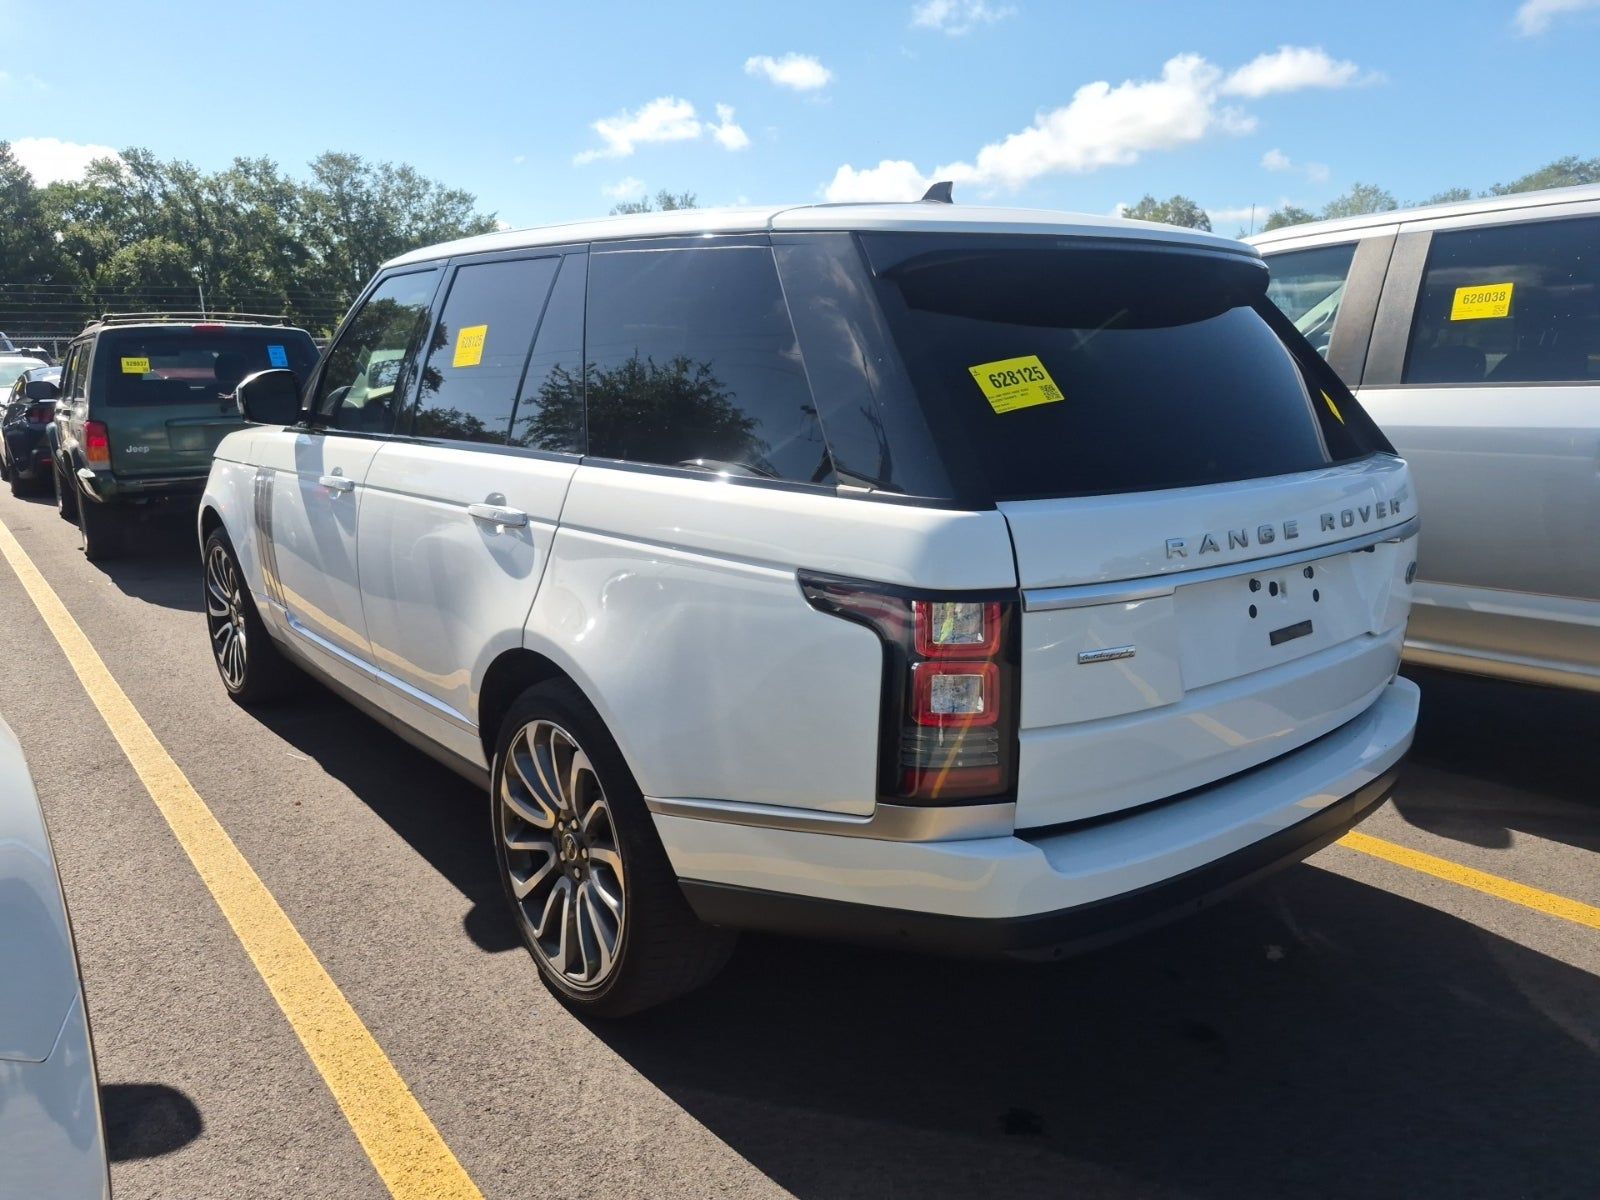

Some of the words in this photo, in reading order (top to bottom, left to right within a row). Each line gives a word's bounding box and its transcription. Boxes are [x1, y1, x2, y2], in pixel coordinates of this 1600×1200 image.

[1463, 291, 1506, 304] 628038
[988, 366, 1045, 388] 628125
[126, 445, 150, 454] Jeep
[1165, 520, 1299, 560] RANGE
[1319, 498, 1401, 532] ROVER
